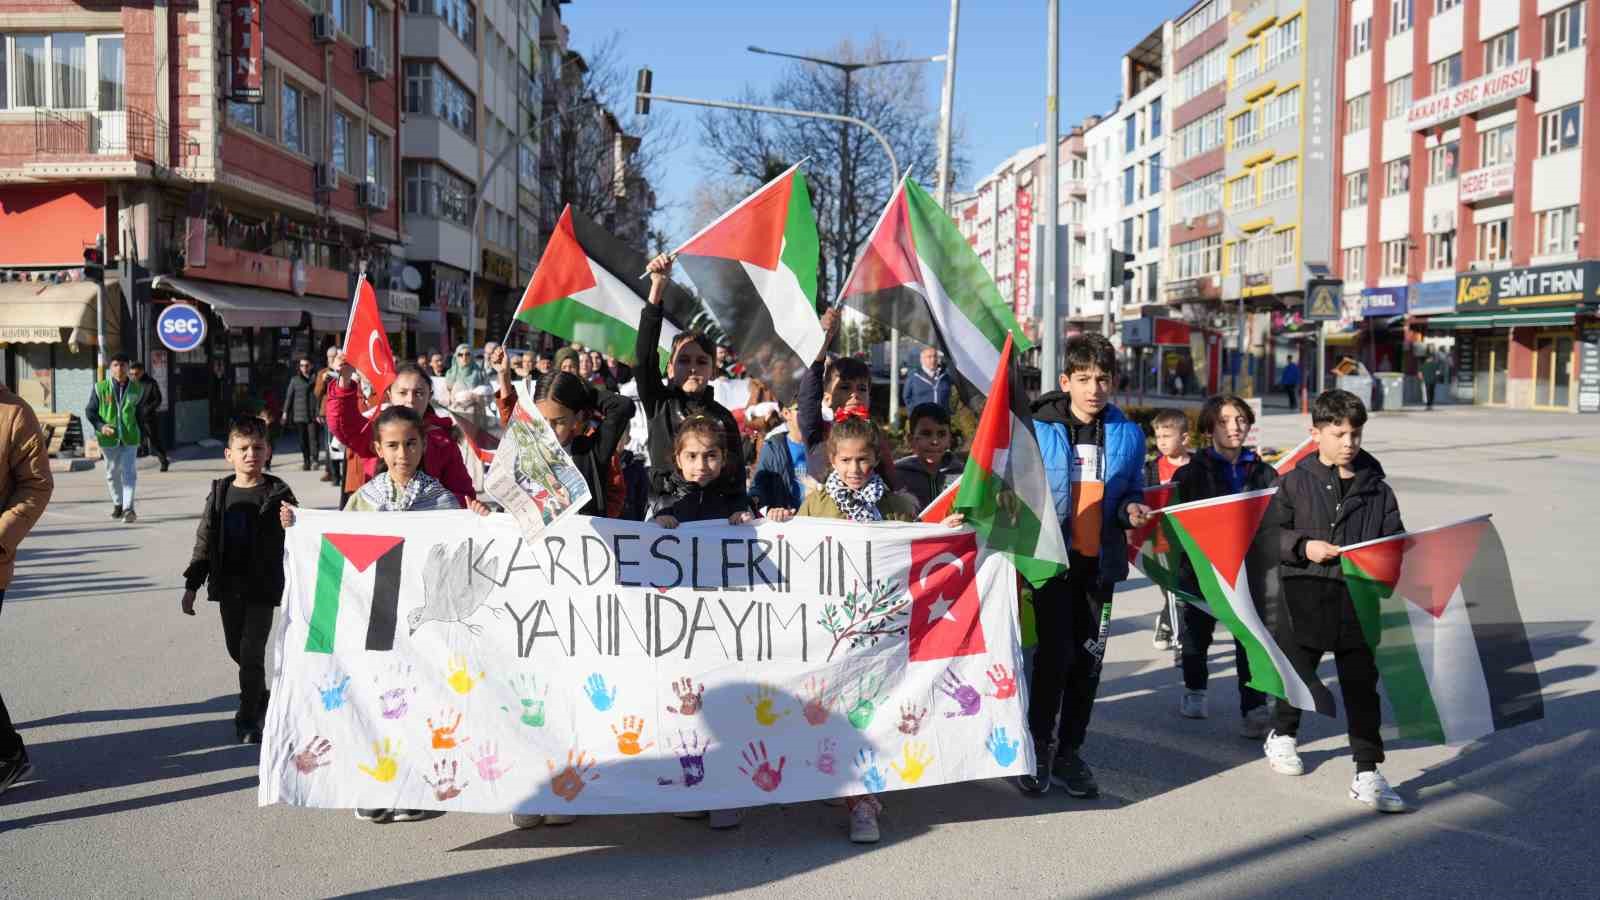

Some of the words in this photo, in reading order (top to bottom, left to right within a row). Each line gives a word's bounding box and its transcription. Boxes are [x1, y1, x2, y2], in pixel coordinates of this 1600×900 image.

[1408, 96, 1450, 122] AKKAYA
[1455, 84, 1479, 107] SRC
[1483, 66, 1529, 95] KURSU
[1498, 269, 1538, 298] SİMİT
[163, 318, 198, 335] seç
[505, 592, 807, 662] YANINDAYIM
